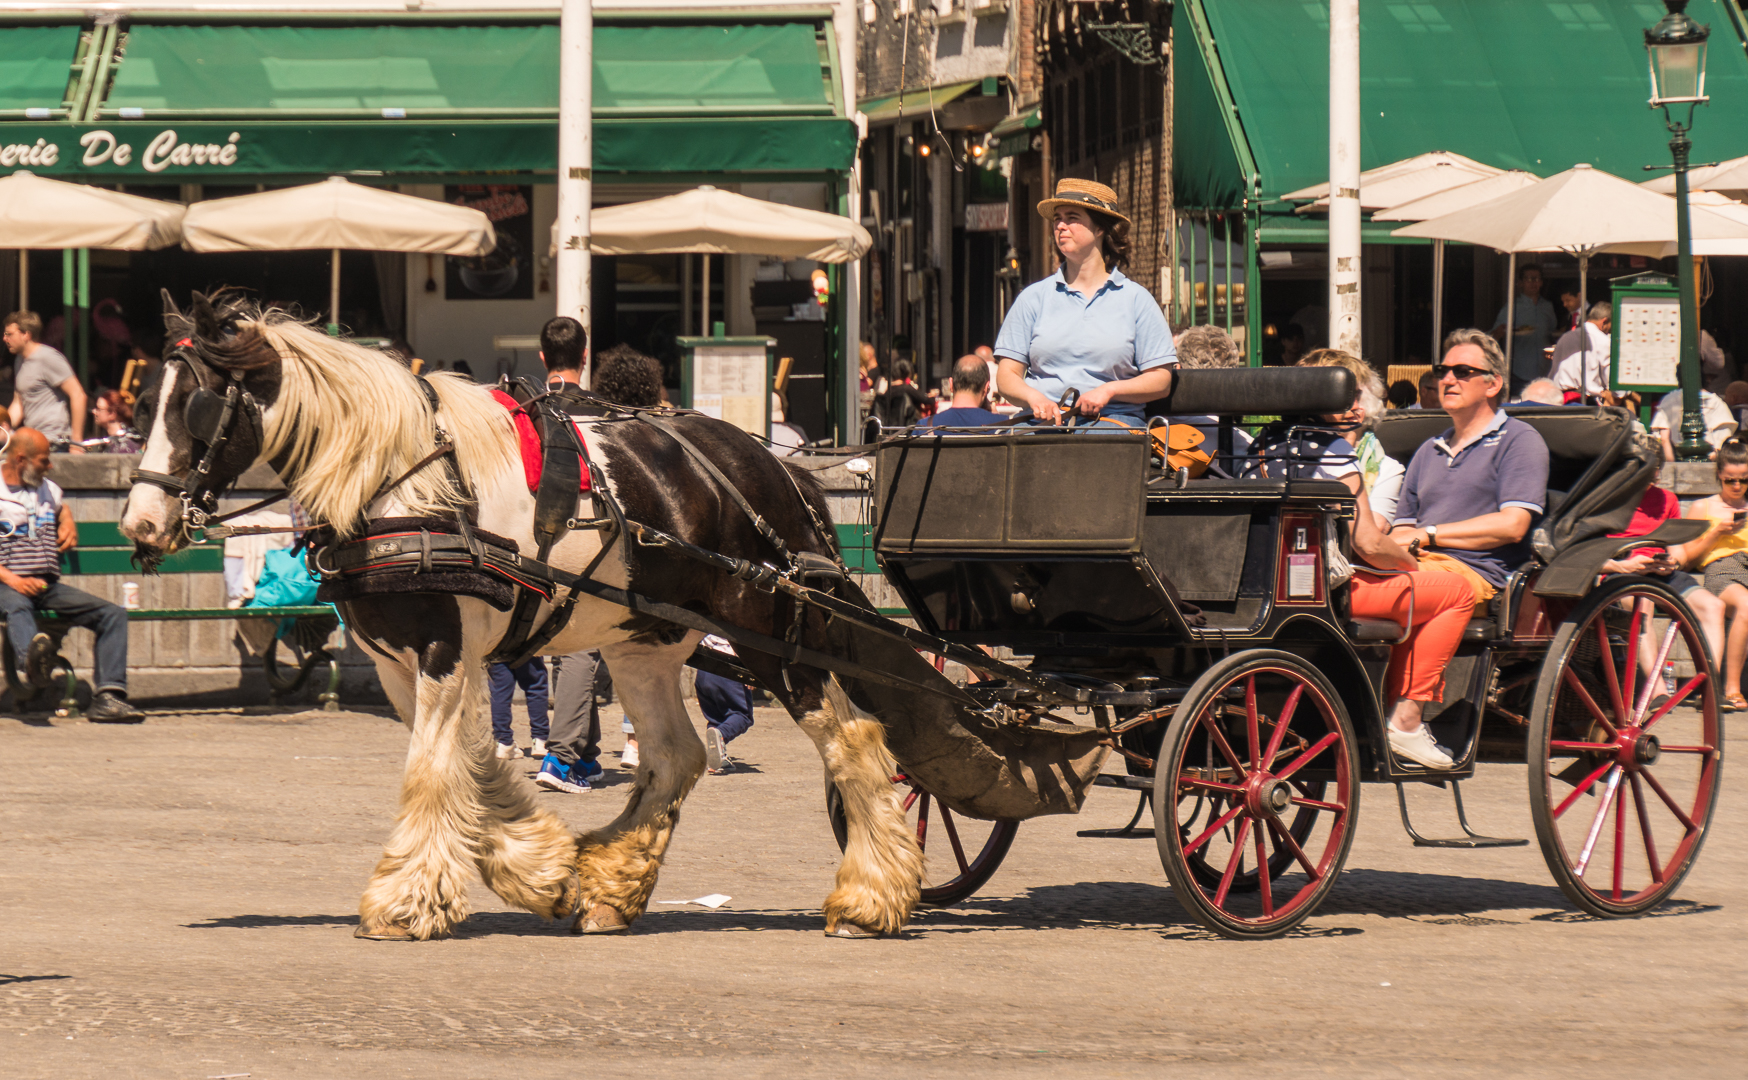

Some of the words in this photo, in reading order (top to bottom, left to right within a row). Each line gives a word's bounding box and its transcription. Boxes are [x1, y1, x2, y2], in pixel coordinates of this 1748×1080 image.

[0, 137, 59, 166] erie
[80, 129, 132, 166] De
[142, 129, 241, 173] Carré
